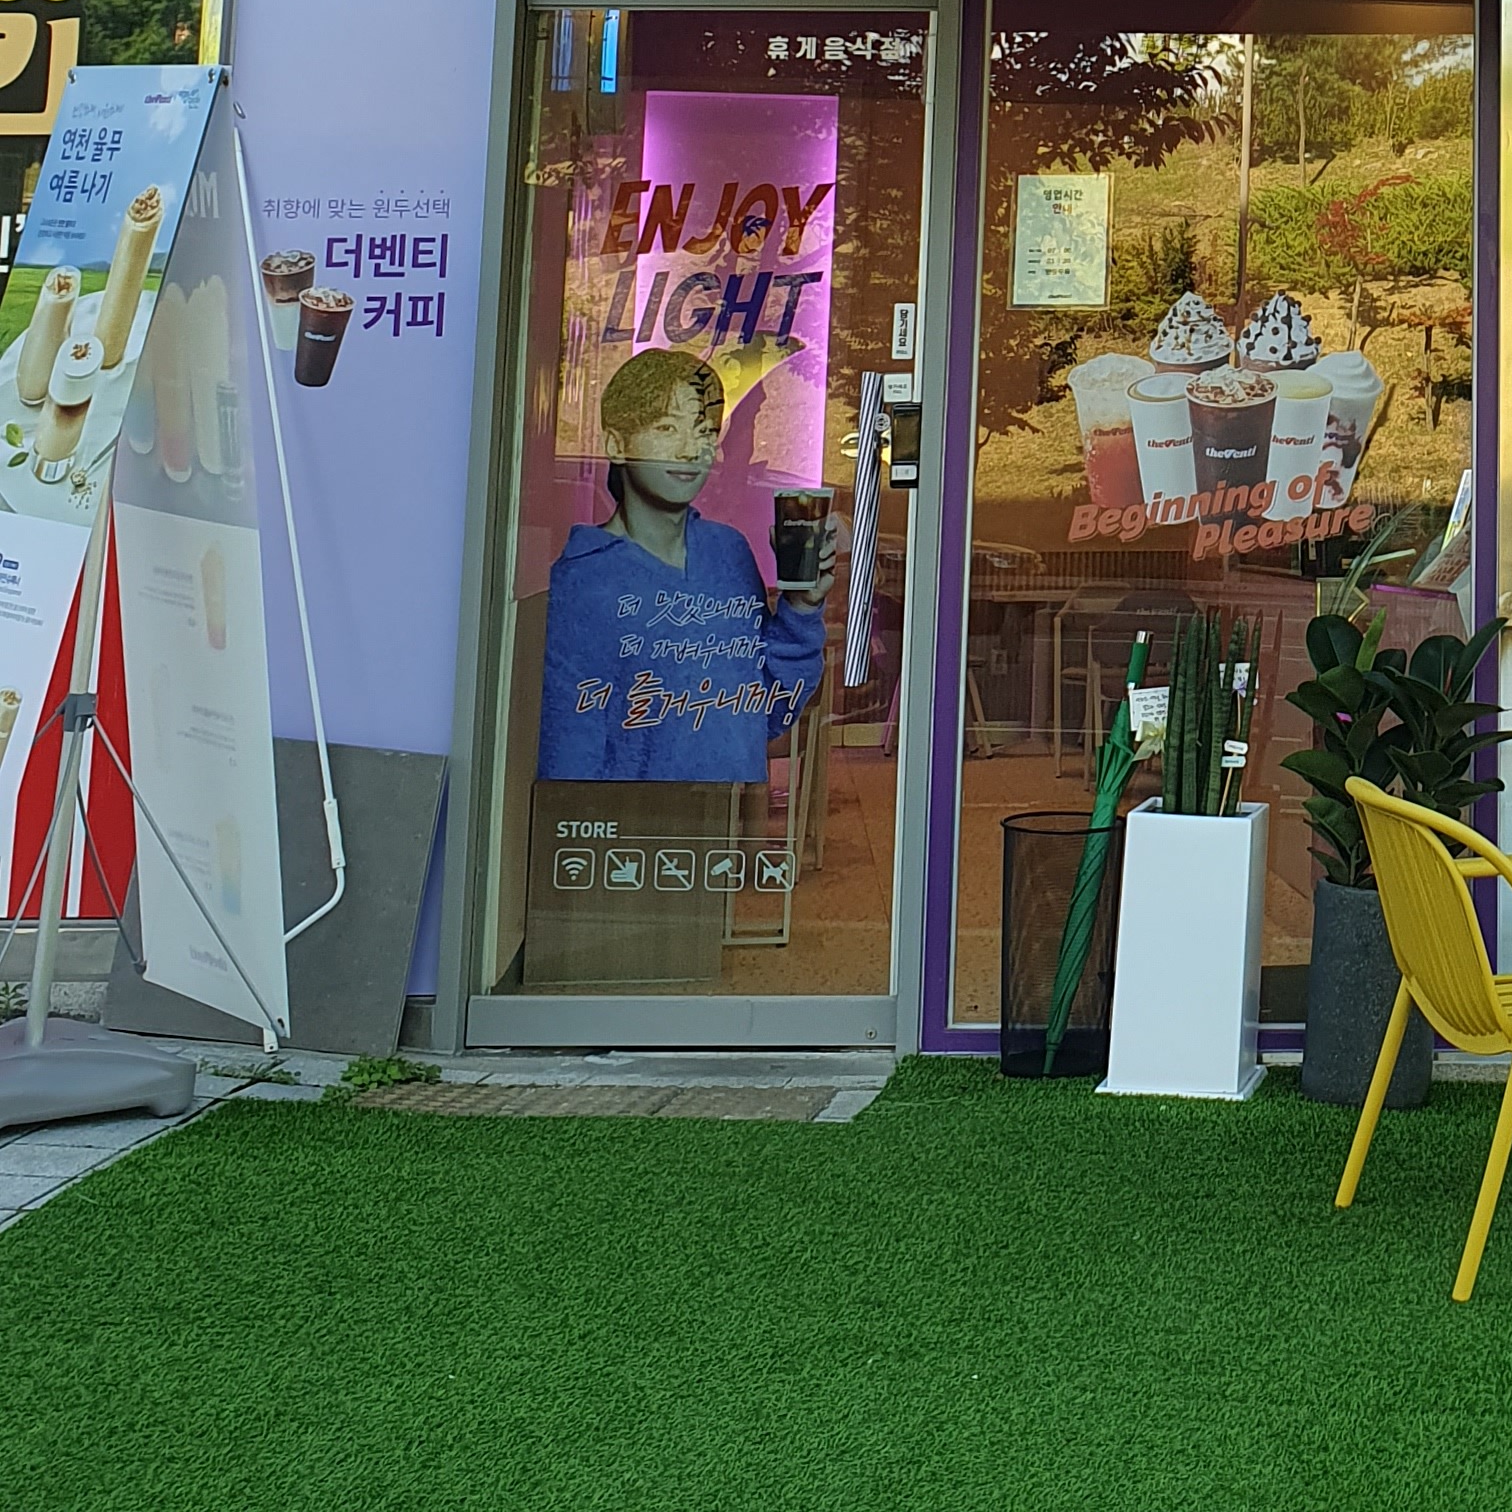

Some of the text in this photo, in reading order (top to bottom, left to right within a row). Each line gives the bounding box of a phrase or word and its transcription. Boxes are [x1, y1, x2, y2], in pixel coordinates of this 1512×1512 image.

[766, 36, 901, 61] 휴게음식점
[61, 127, 124, 162] 연천 율무
[50, 169, 114, 204] 여름 나기
[1043, 190, 1083, 201] 영업시간
[262, 198, 451, 220] 취향에 맞는 원두선택
[601, 180, 838, 256] ENJOY
[326, 233, 449, 279] 더벤티
[363, 292, 446, 337] 커피
[601, 271, 823, 346] LIGHT
[1068, 460, 1336, 544] Beginning of
[1193, 501, 1375, 561] Pleasure
[617, 590, 765, 629] 더 맛있으니까,
[619, 633, 644, 658] 더
[576, 671, 804, 730] 더 즐거우니까!
[556, 821, 618, 839] STORE
